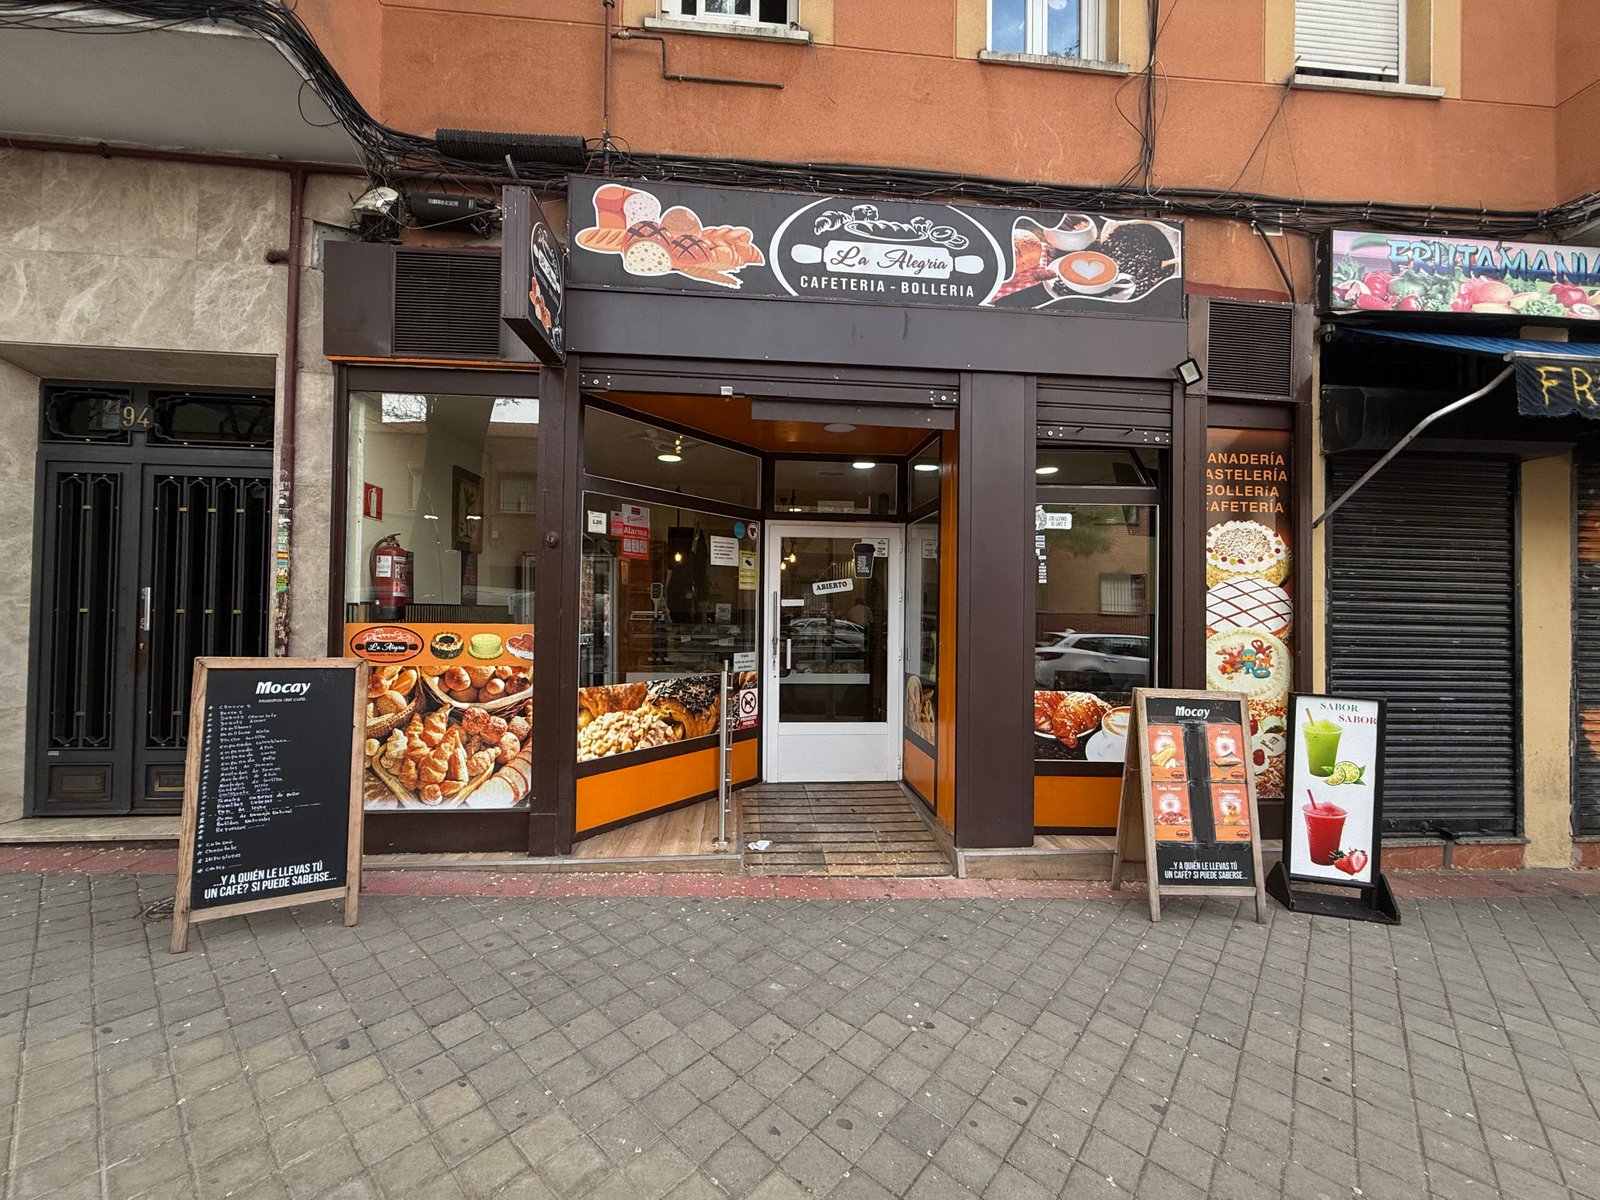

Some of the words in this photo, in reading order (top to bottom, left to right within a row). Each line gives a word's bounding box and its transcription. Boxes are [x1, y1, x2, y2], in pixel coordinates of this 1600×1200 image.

[830, 246, 870, 268] La
[800, 275, 885, 292] CAFETERIA
[901, 281, 975, 298] BOLLERIA
[1536, 366, 1600, 407] FR
[122, 404, 150, 428] 94
[1206, 499, 1284, 513] AFETERÍA
[624, 526, 648, 536] Alarma
[816, 581, 848, 591] ABIERTO
[255, 681, 311, 696] Mocay
[1175, 706, 1210, 719] Mocay
[1320, 702, 1359, 712] SABOR
[1338, 714, 1376, 725] SABOR
[229, 874, 236, 884] A
[238, 868, 265, 883] QUIÉN
[266, 868, 278, 878] LE
[279, 863, 311, 877] LLEVAS
[312, 860, 323, 872] TÚ
[1178, 862, 1183, 870] A
[1184, 860, 1200, 870] QUIÉN
[1202, 862, 1209, 870] LE
[1209, 862, 1230, 870] LLEVAS
[1230, 861, 1238, 870] TÚ
[1164, 871, 1173, 879] UN
[1174, 869, 1192, 879] CAFÉ?
[1193, 871, 1199, 879] SI
[1200, 871, 1218, 879] PUEDE
[204, 888, 218, 899] UN
[220, 883, 249, 897] CAFÉ?
[251, 882, 260, 892] SI
[262, 878, 290, 890] PUEDE
